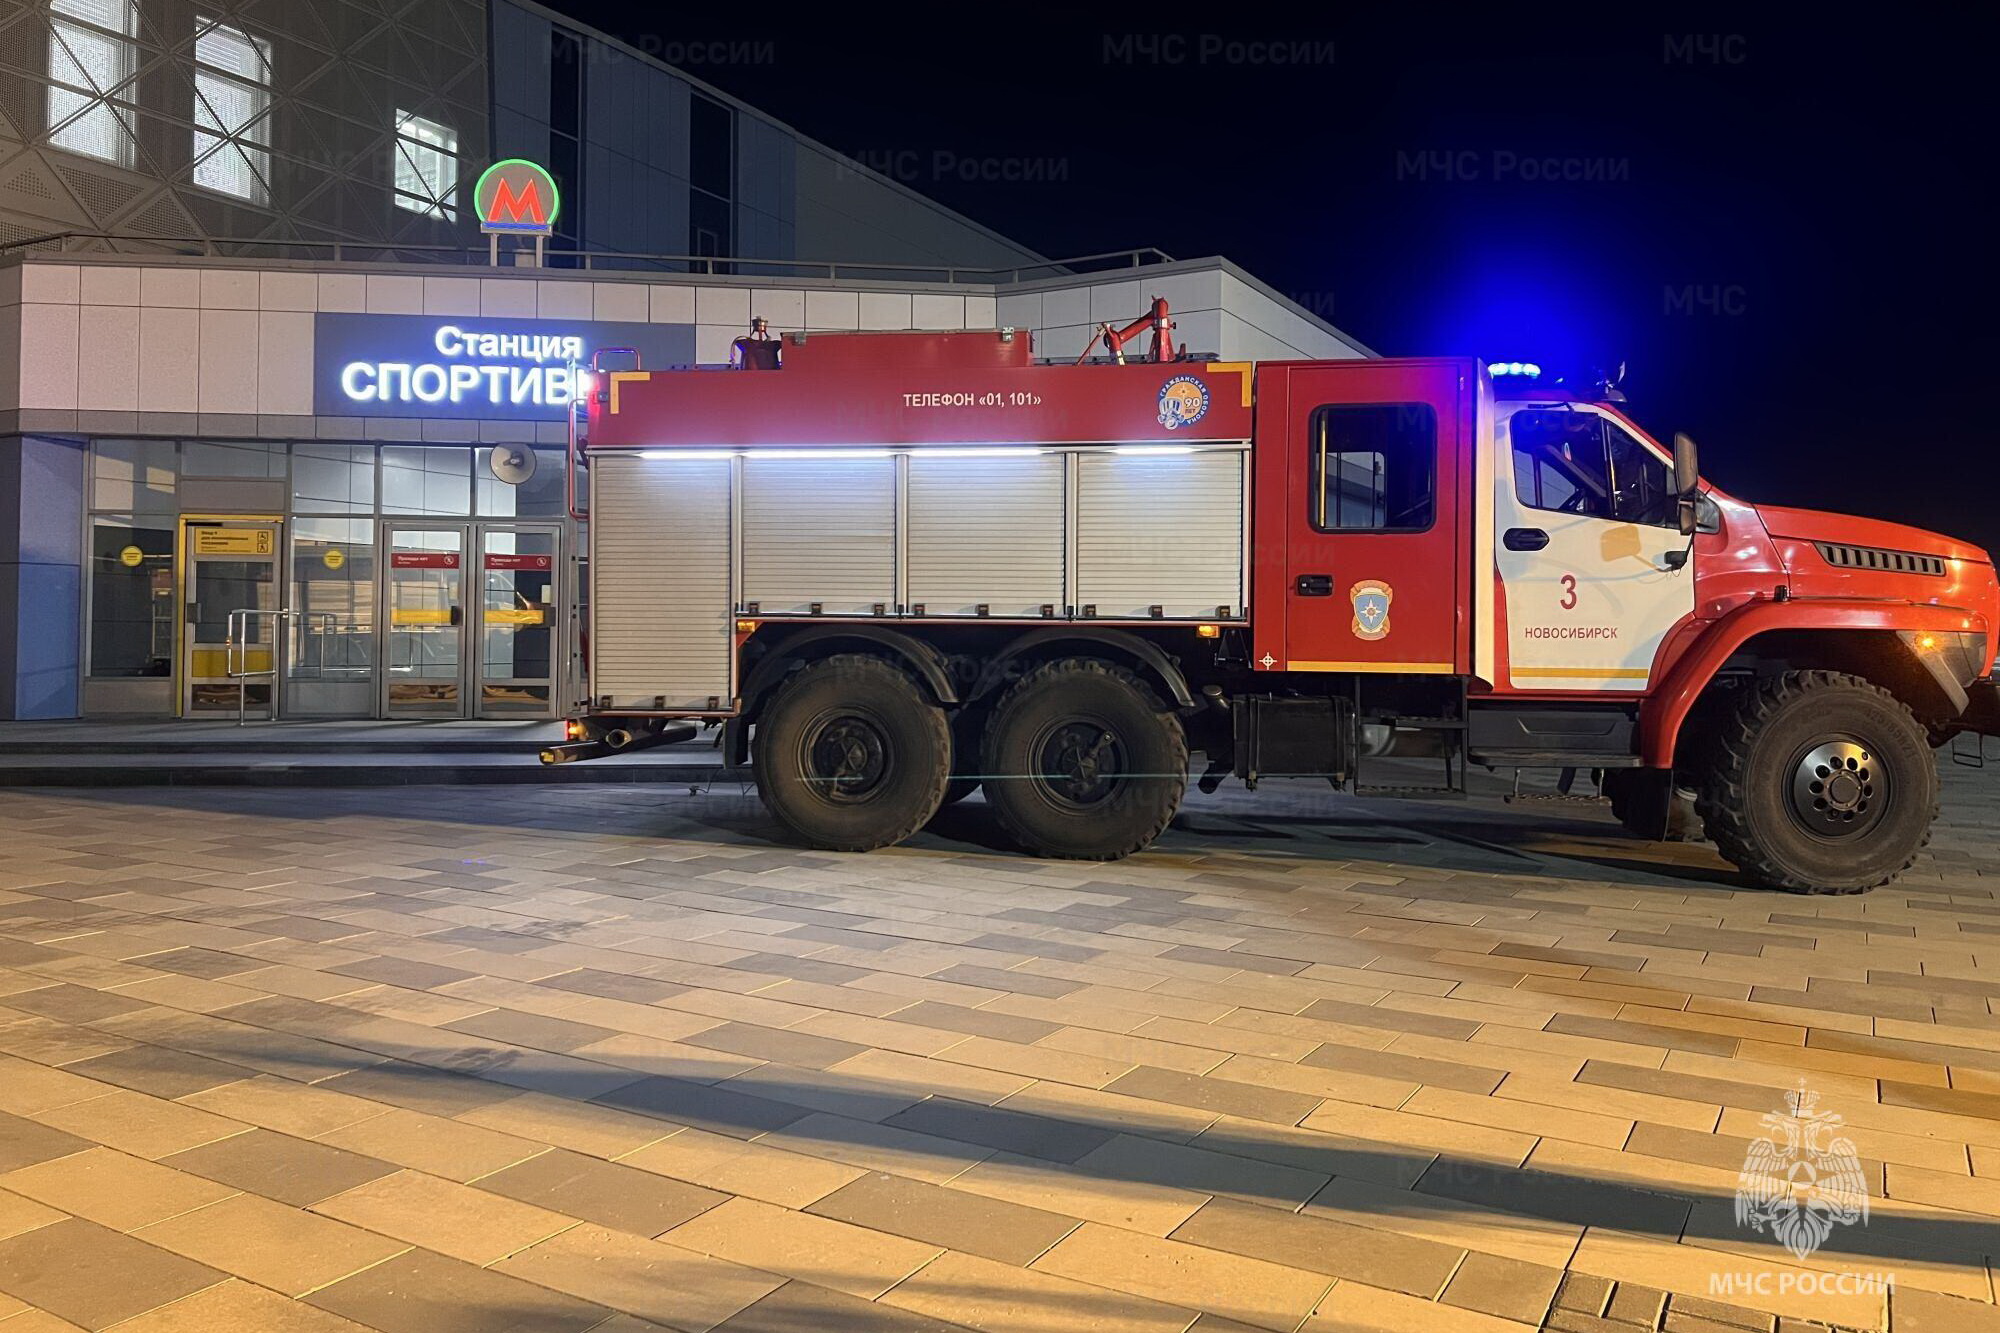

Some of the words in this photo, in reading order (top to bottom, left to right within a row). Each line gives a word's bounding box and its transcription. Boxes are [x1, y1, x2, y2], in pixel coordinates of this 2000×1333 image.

[488, 178, 548, 223] М
[435, 325, 583, 362] Станция
[1159, 376, 1207, 397] ГРАЖДАНСКАЯ
[903, 393, 975, 407] ТЕЛЕФОН
[978, 392, 1005, 408] «01,
[1009, 392, 1042, 406] 101»
[1184, 397, 1201, 408] 90
[1186, 394, 1209, 425] ОБОРОНА
[1560, 574, 1577, 610] 3
[1525, 627, 1618, 639] НОВОСИБИРСК
